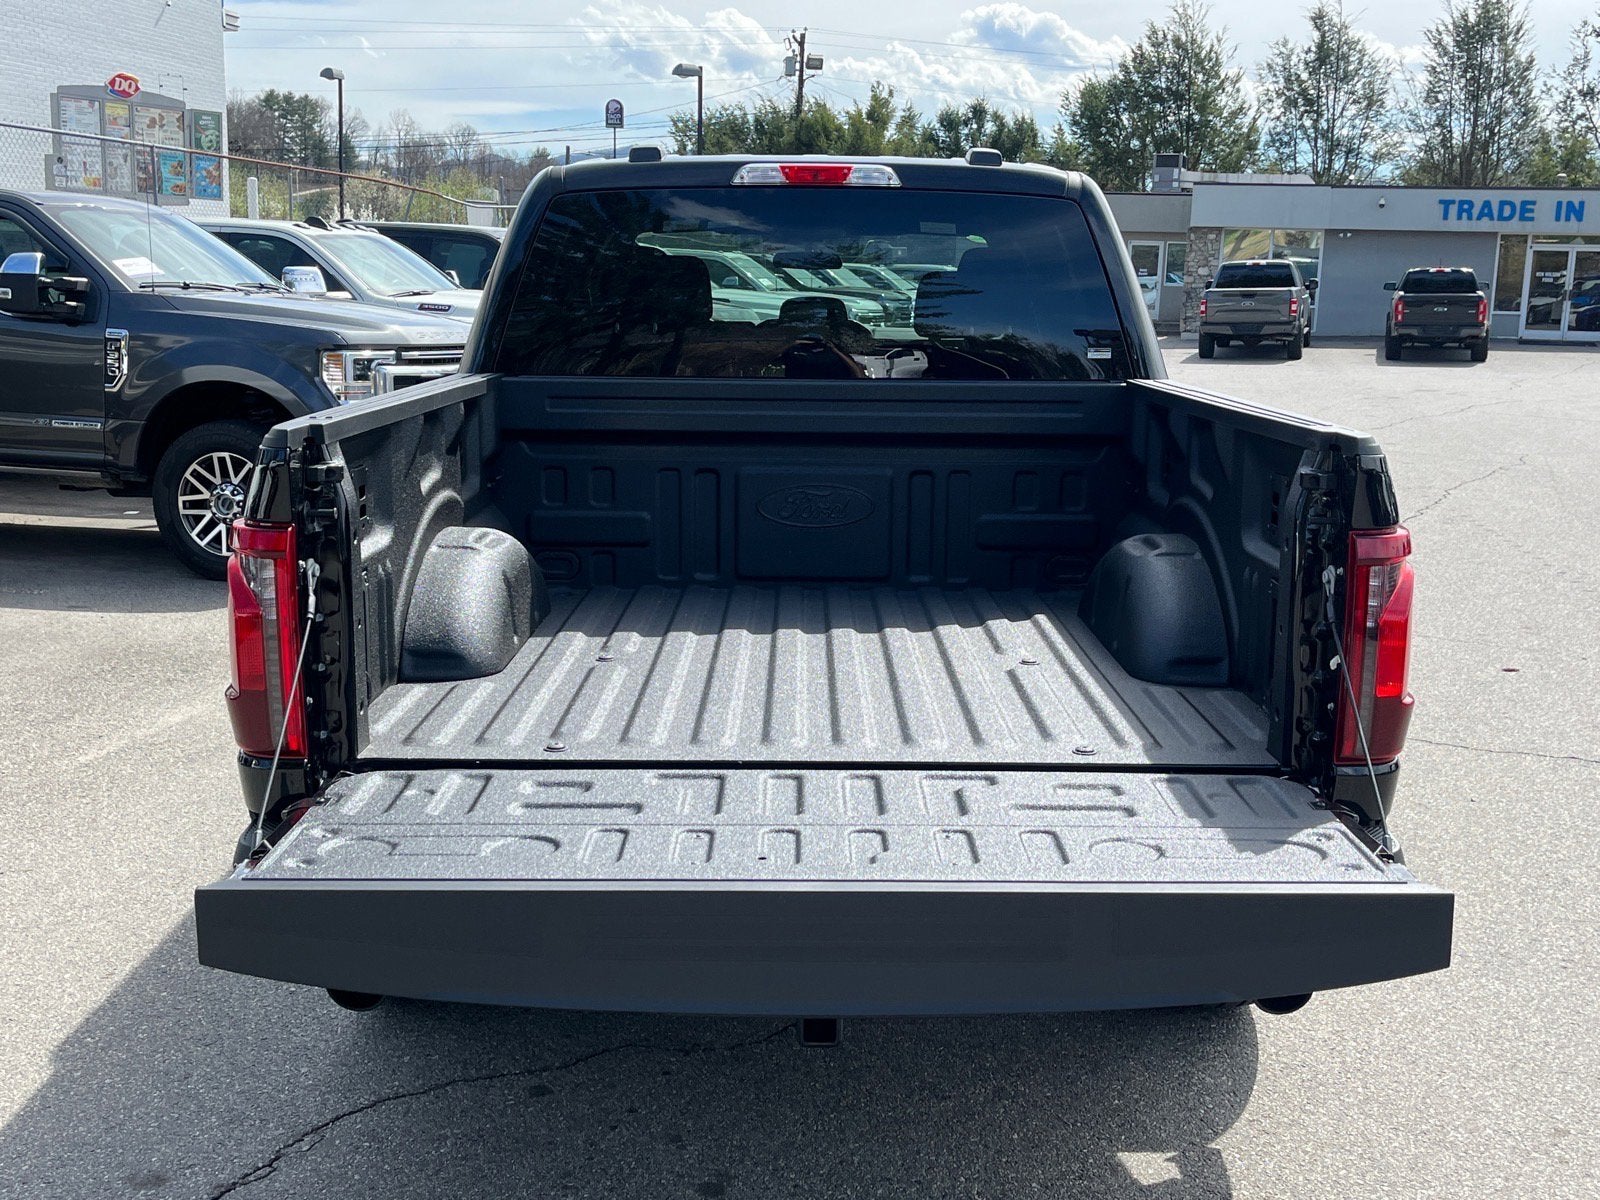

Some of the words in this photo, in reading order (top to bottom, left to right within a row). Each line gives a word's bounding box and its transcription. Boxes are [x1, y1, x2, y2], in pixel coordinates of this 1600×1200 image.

[114, 77, 136, 95] DQ
[1438, 199, 1537, 222] TRADE
[1554, 200, 1585, 222] IN
[778, 488, 851, 519] Ford
